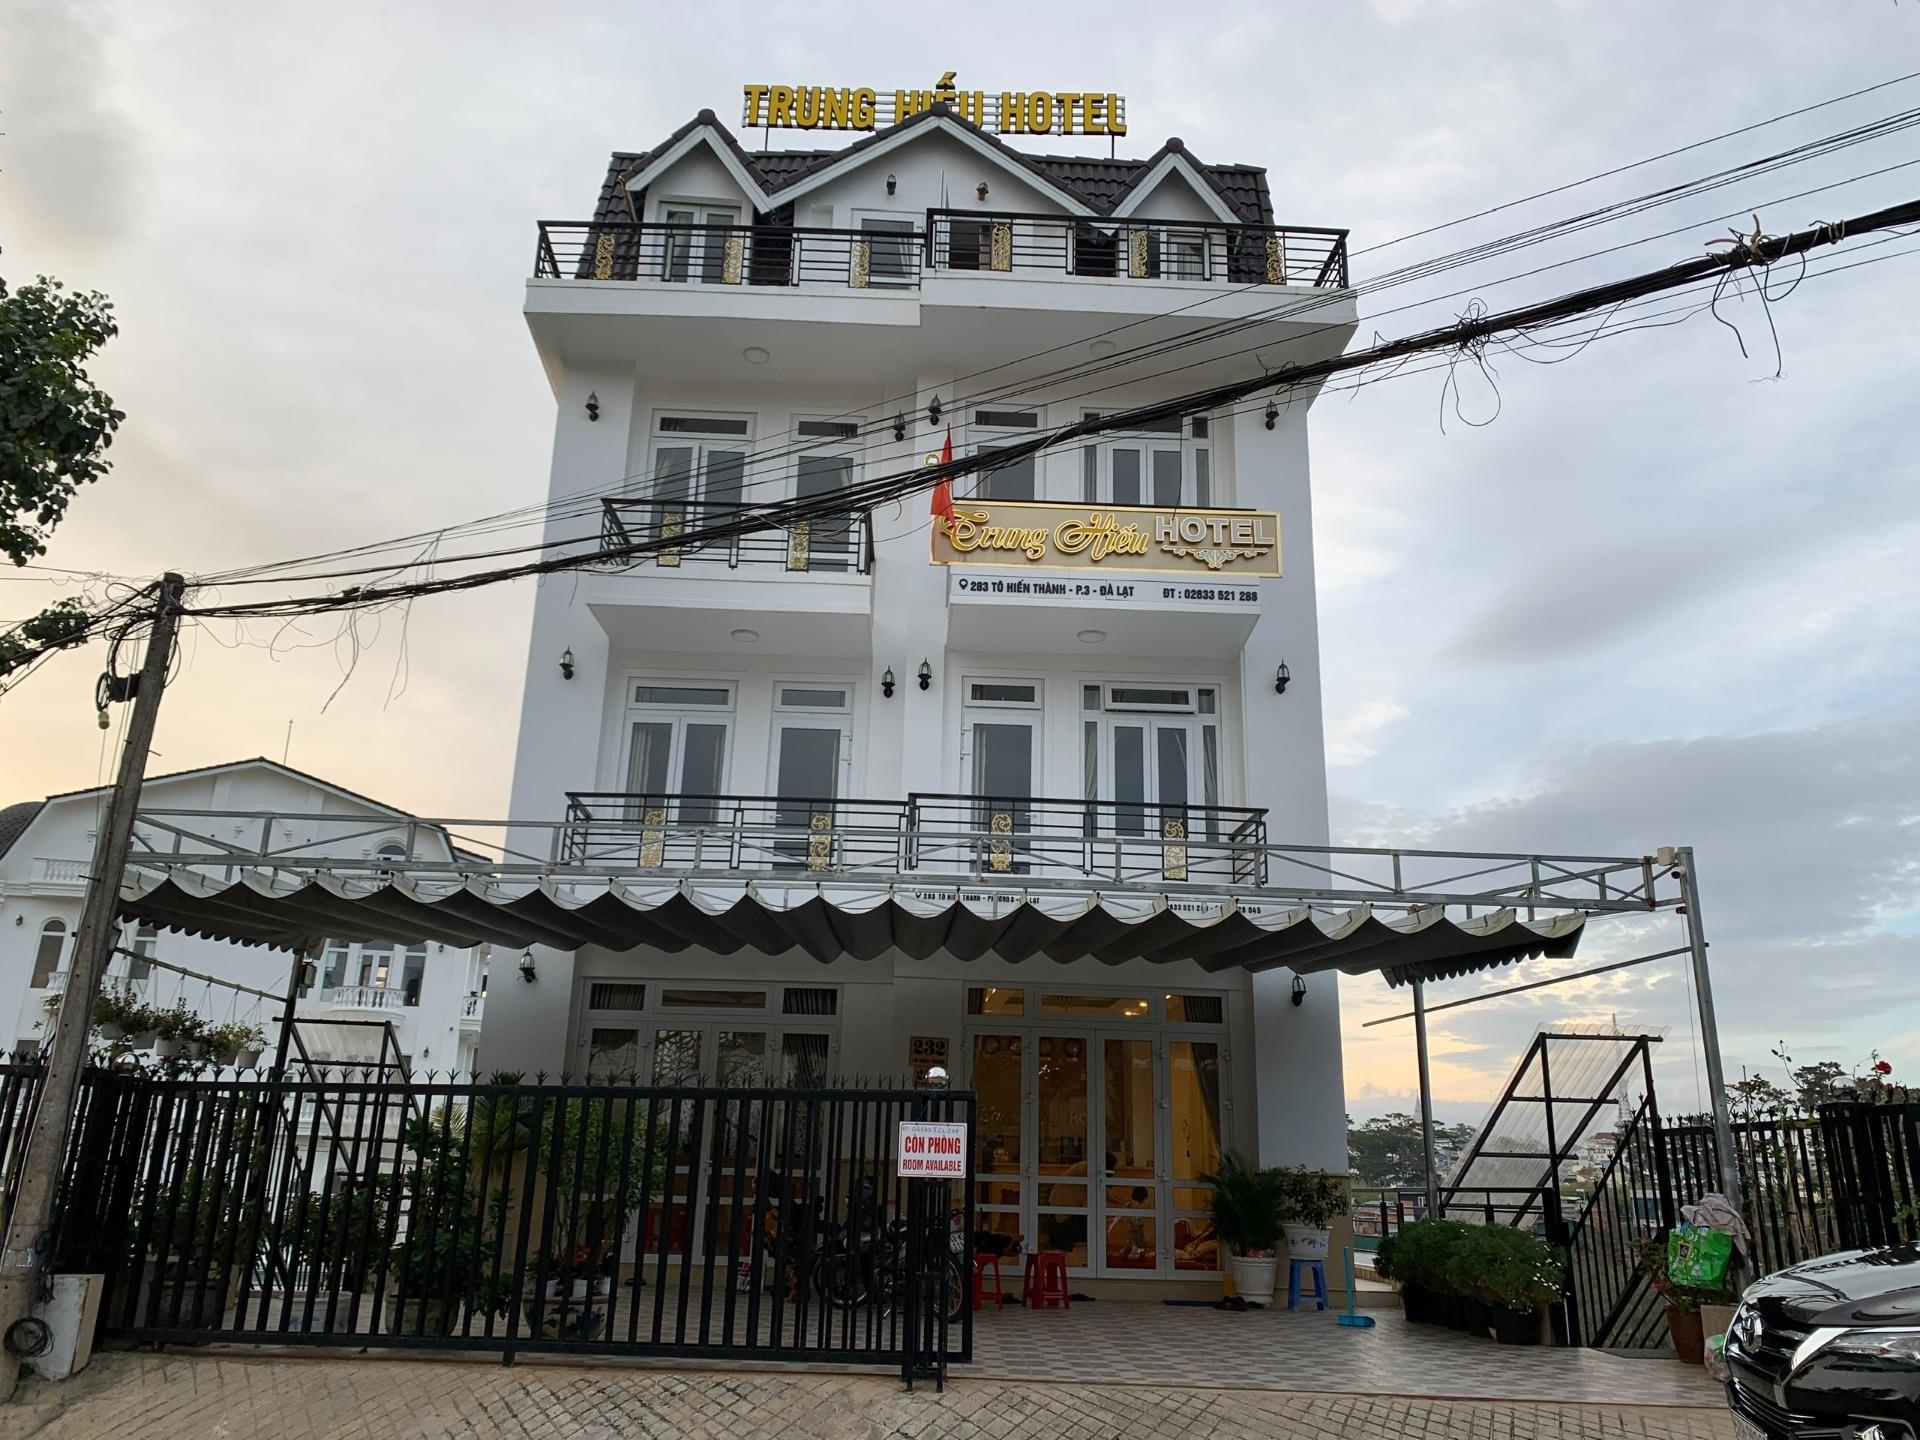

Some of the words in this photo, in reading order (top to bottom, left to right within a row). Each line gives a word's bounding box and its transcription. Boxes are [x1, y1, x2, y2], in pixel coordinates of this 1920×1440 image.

[744, 84, 877, 130] TRUNG
[1001, 92, 1127, 136] HOTEL
[940, 509, 1048, 560] Trung
[1054, 513, 1149, 561] Hiếu
[1156, 516, 1275, 545] HOTEL
[991, 580, 1003, 592] TÔ
[1006, 579, 1030, 594] HIẾN
[1033, 582, 1066, 595] THÀNH
[1076, 585, 1090, 596] P.3
[1100, 584, 1115, 597] ĐÀ
[1116, 585, 1134, 599] LẠT
[1218, 590, 1235, 600] 521
[912, 1040, 946, 1056] 232
[905, 1134, 925, 1154] CÒN
[928, 1135, 961, 1154] PHÒNG
[903, 1159, 924, 1170] ROOM
[925, 1160, 962, 1171] AVAILABLE
